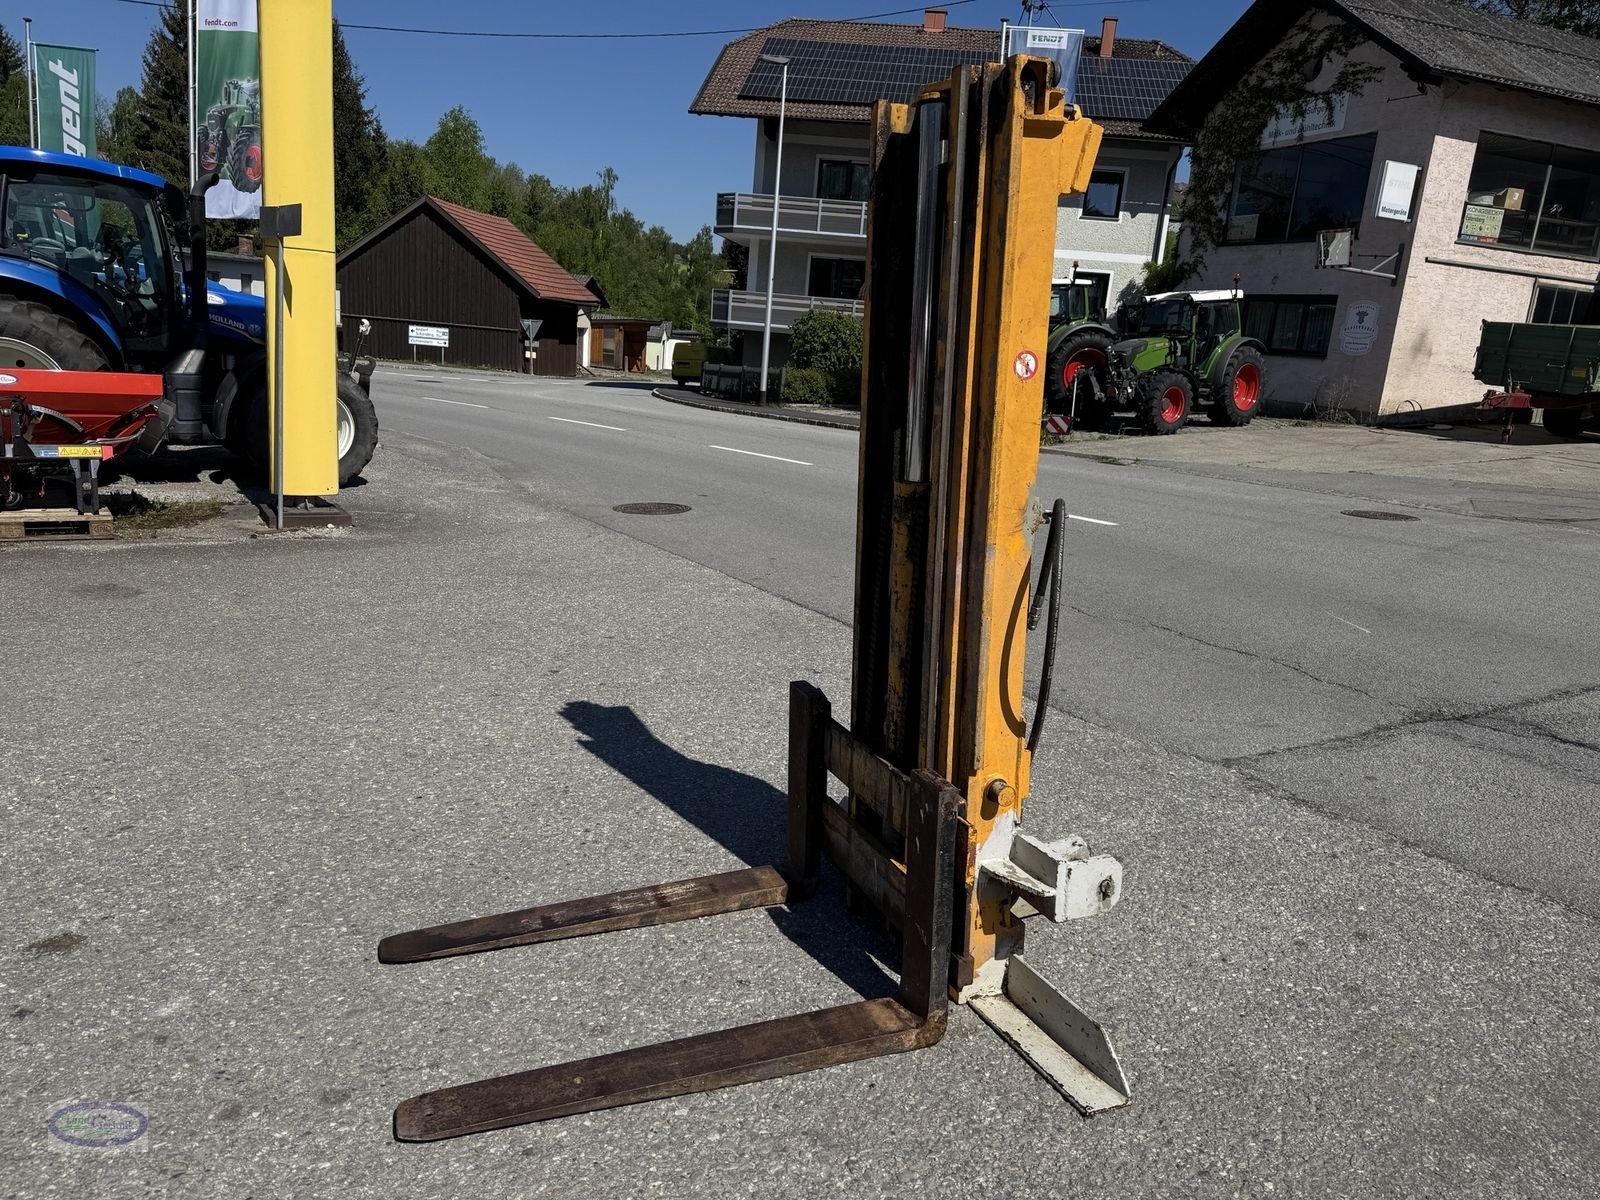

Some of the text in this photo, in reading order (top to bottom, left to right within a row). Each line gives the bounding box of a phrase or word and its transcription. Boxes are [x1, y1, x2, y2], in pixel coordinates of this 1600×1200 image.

[204, 18, 238, 27] fendt.com
[1031, 34, 1064, 43] FENDT
[1381, 205, 1407, 216] Motorgeräte
[208, 313, 245, 330] HOLLAND
